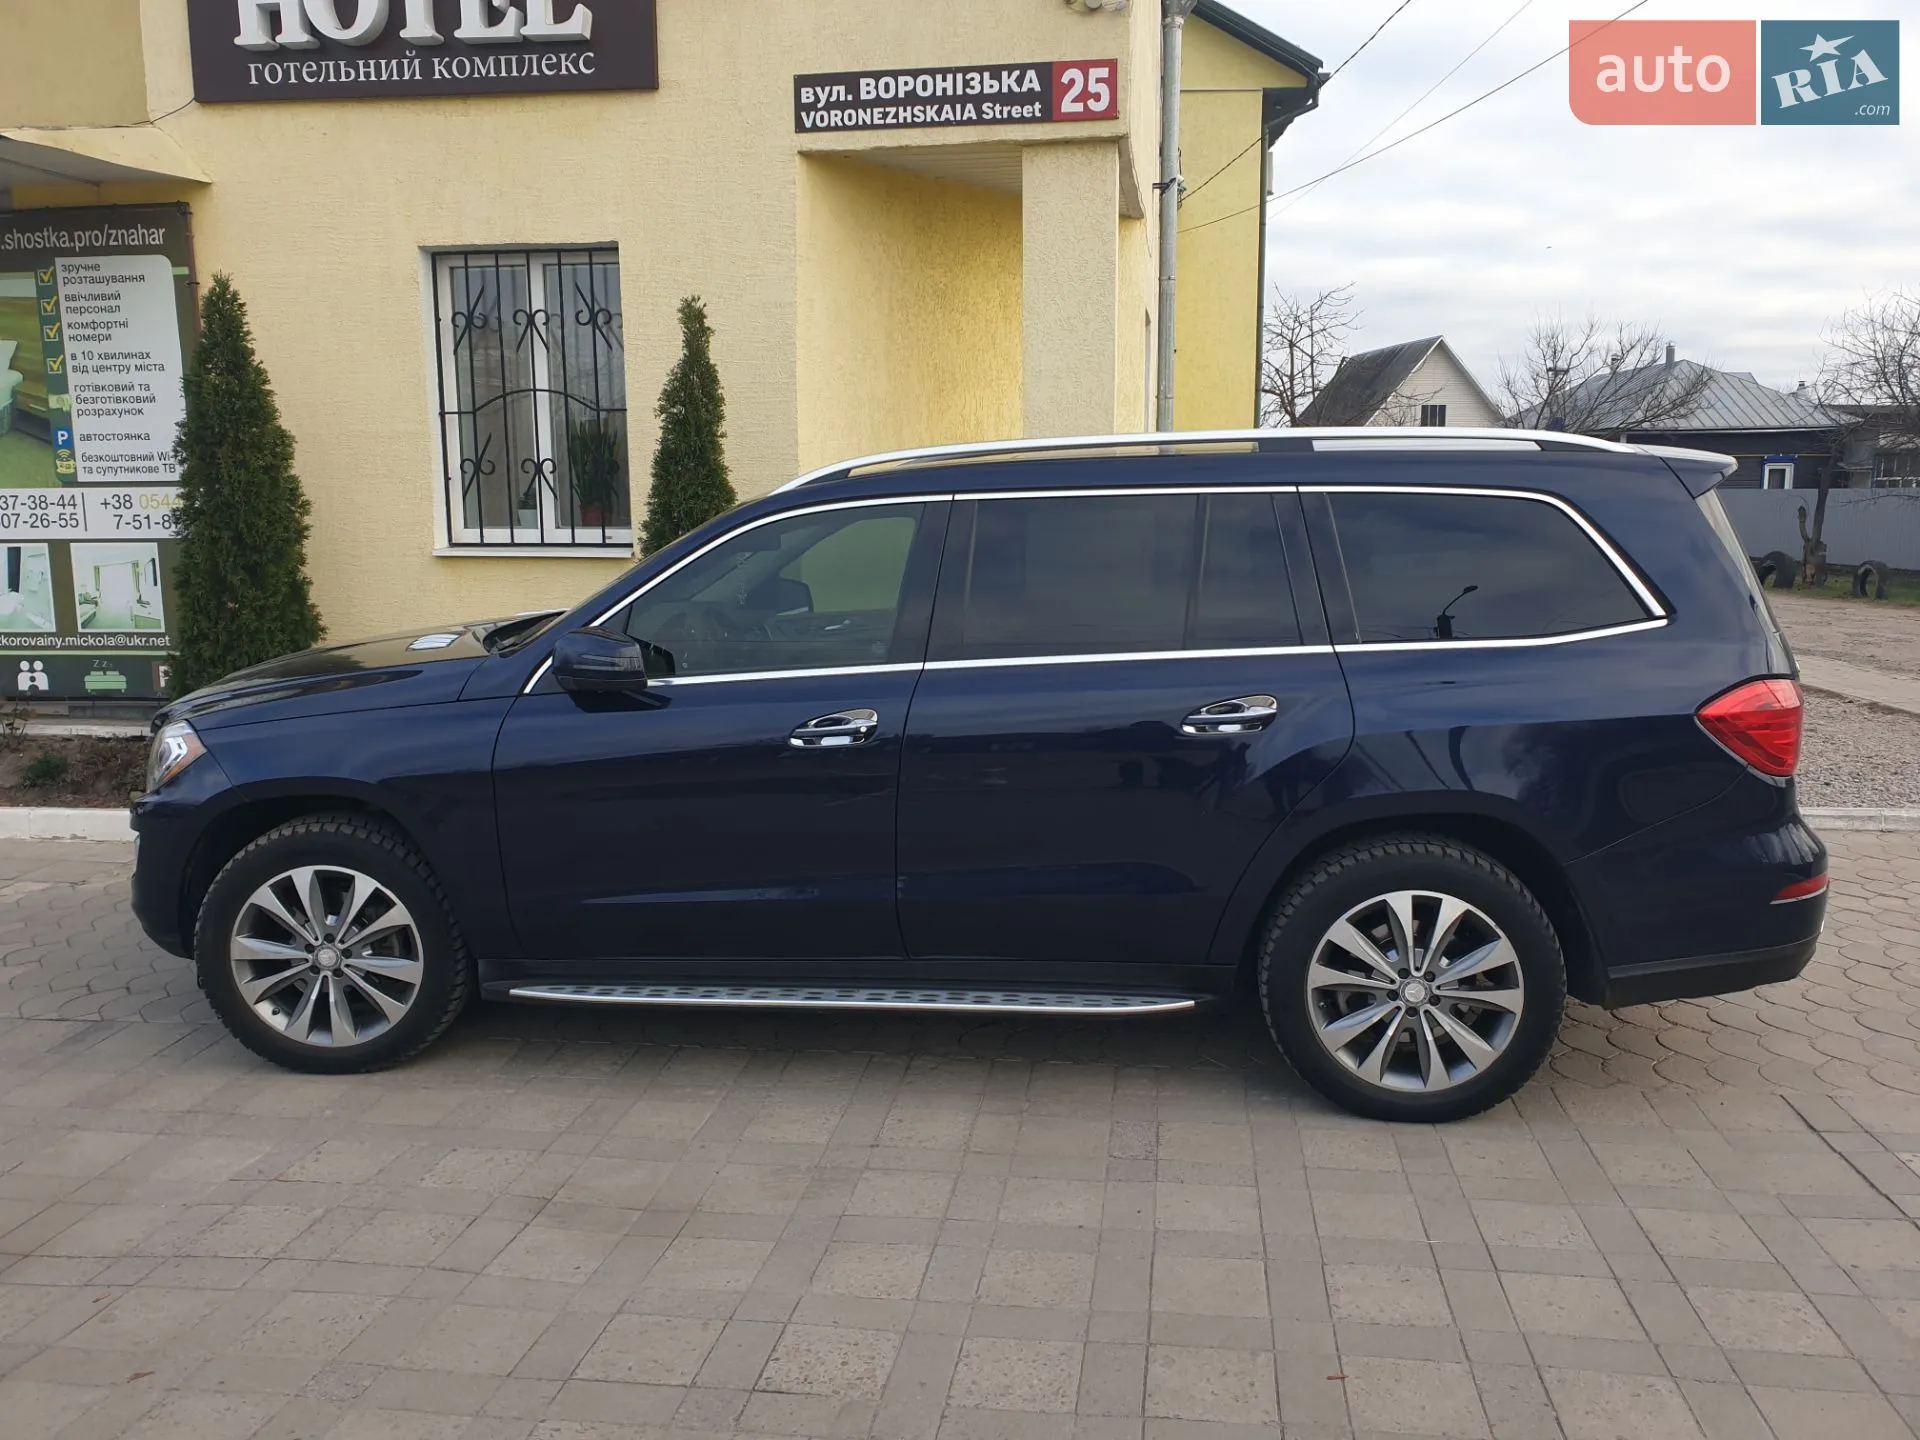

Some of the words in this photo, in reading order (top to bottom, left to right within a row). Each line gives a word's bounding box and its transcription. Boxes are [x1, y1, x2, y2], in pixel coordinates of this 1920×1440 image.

[247, 49, 423, 85] готельний
[431, 50, 596, 80] комплекс
[800, 85, 853, 108] вул.
[859, 68, 1041, 100] ВОРОНІЗЬКА
[1060, 66, 1111, 113] 25
[800, 103, 977, 128] VORONEZHSKAIA
[981, 101, 1042, 120] Street
[61, 263, 101, 273] зручне
[62, 273, 146, 286] розташування
[64, 290, 121, 302] ввічливий
[65, 304, 121, 316] персонал
[67, 318, 129, 332] комфортні
[68, 333, 112, 344] номери
[70, 353, 77, 361] в
[81, 350, 94, 361] 10
[97, 351, 152, 360] хвилинах
[72, 363, 89, 374] від
[92, 363, 131, 374] центру
[134, 362, 165, 372] міста
[74, 381, 135, 393] готівковий
[75, 393, 156, 405] безготівковий
[77, 407, 145, 419] розрахунок
[79, 432, 151, 441] автостоянка
[81, 451, 155, 463] безкоштовний
[82, 466, 94, 474] та
[96, 464, 160, 476] супутникове
[162, 463, 176, 473] ТВ
[100, 493, 134, 510] +38
